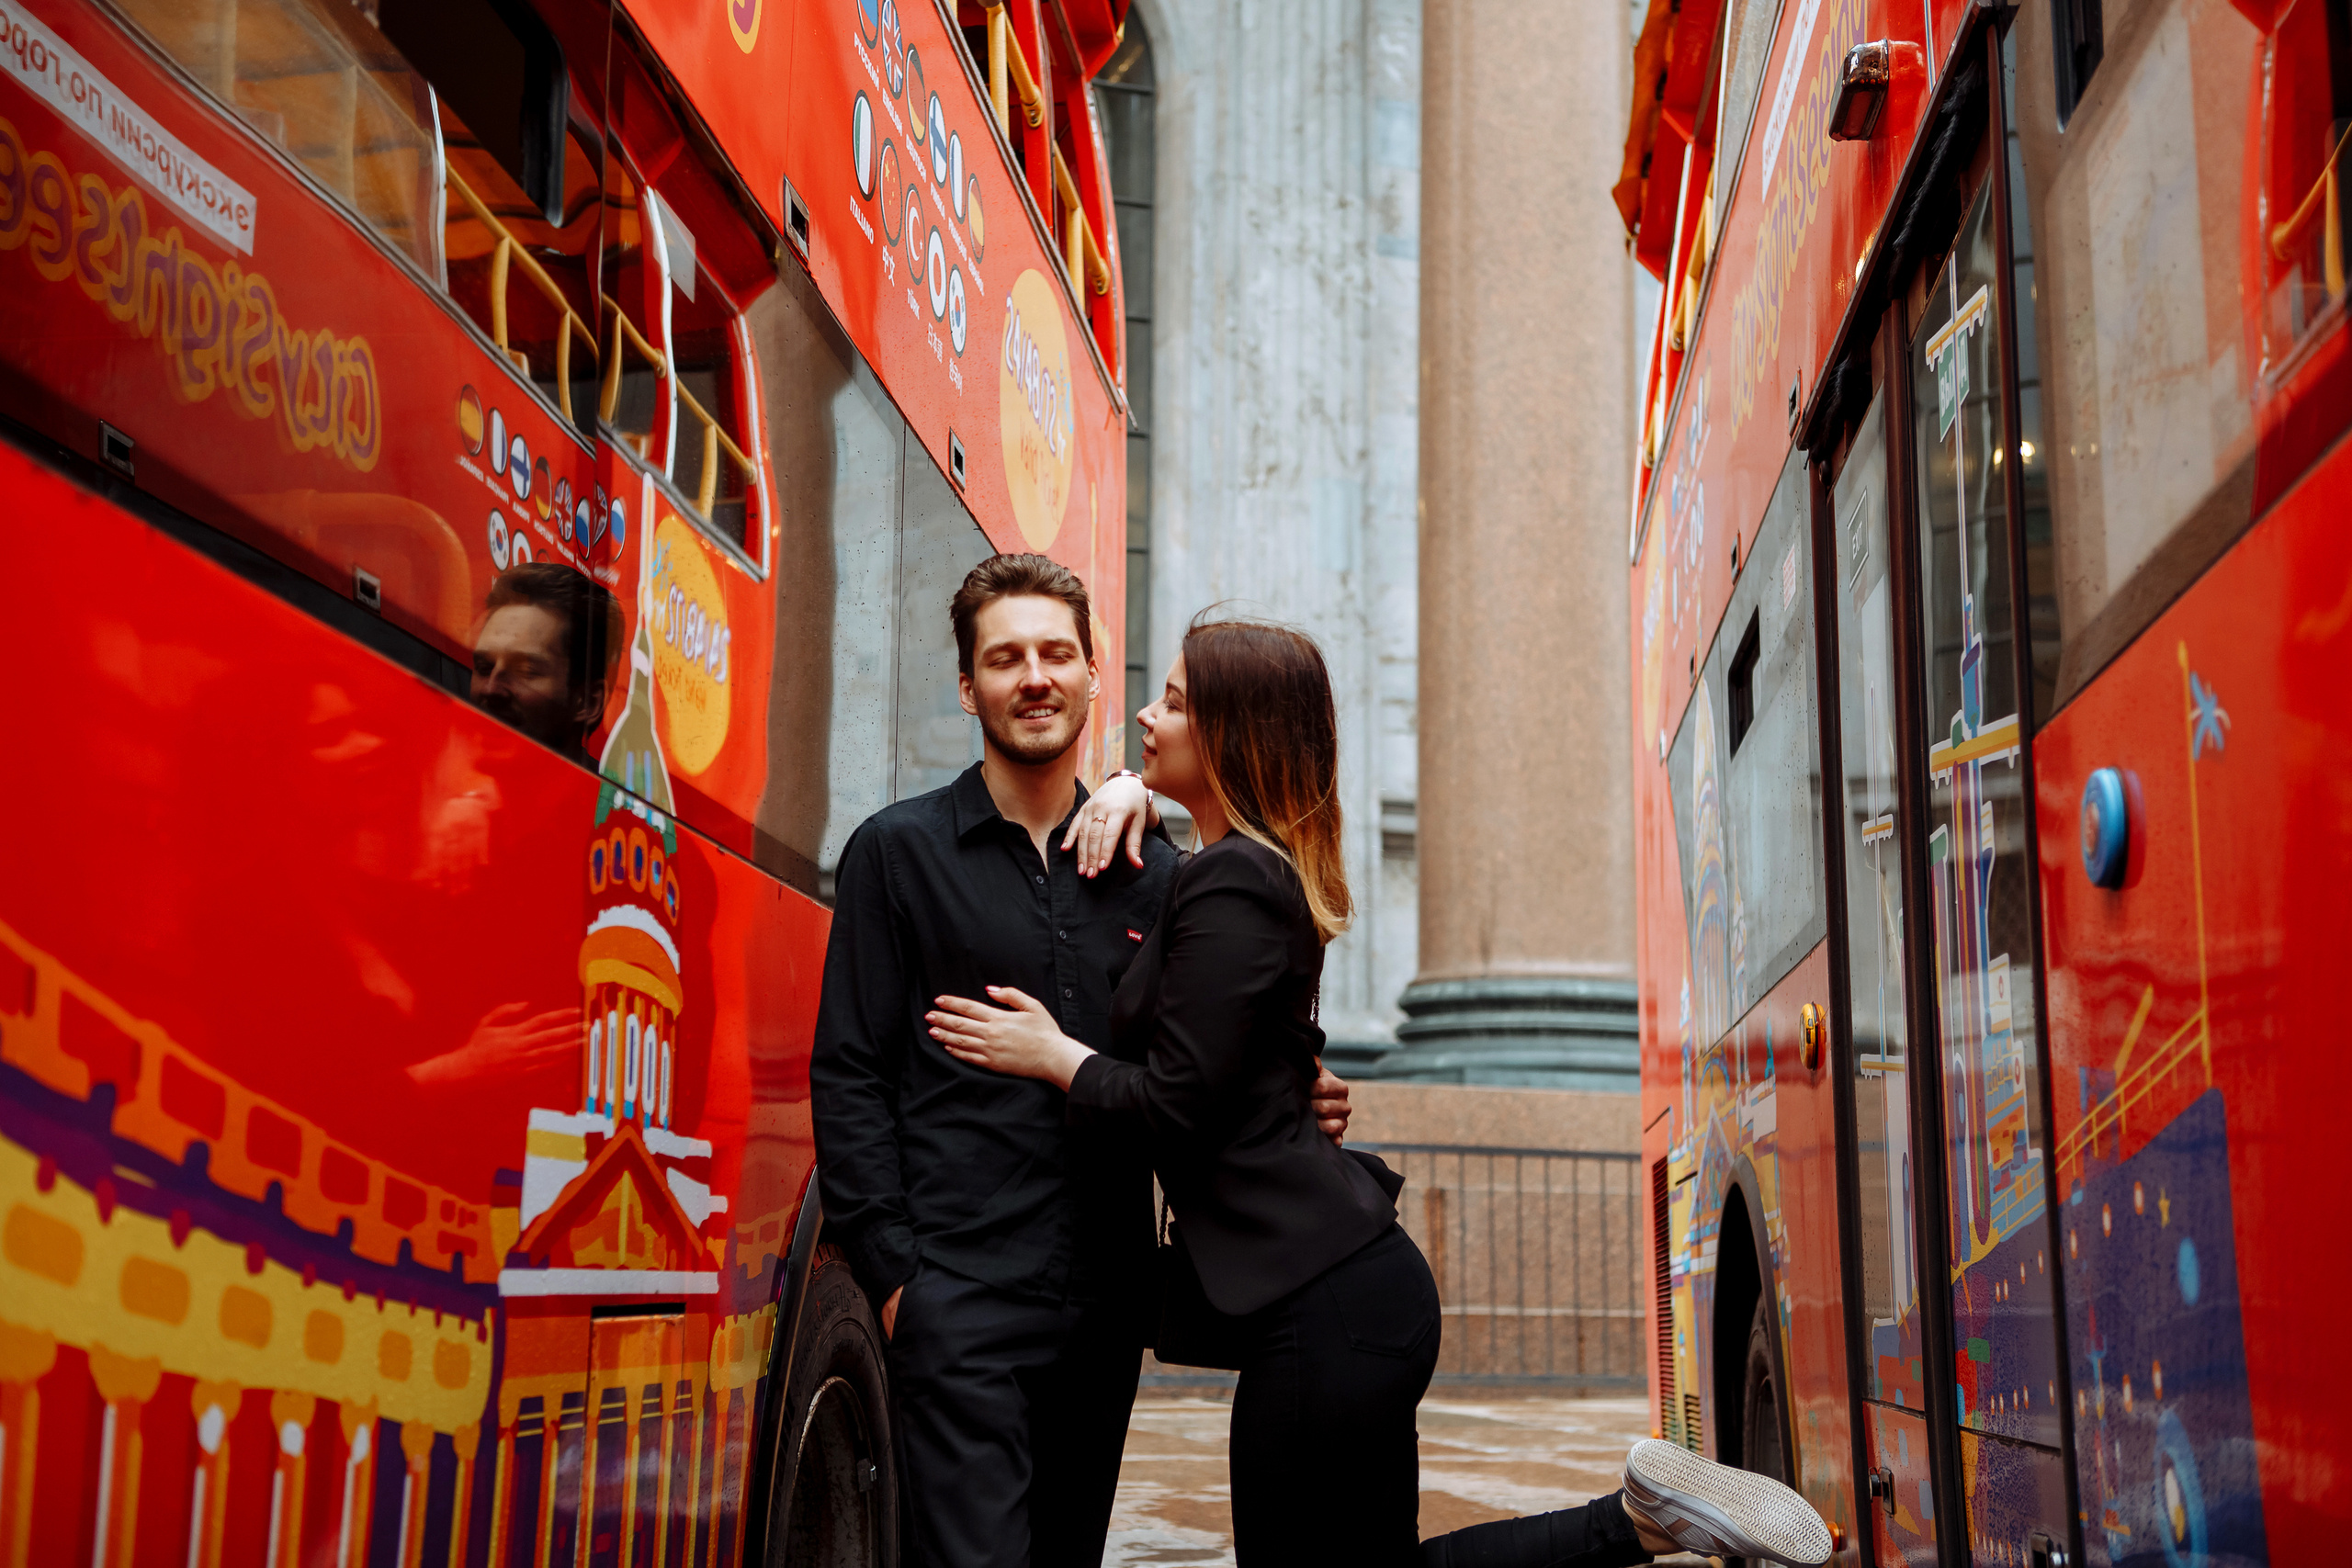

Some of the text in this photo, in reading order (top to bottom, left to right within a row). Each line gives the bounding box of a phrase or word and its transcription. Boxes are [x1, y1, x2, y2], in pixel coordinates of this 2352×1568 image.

[854, 32, 879, 91] РУССКИЙ
[882, 87, 902, 137] ENGLISH
[850, 195, 874, 244] ITALIANO
[882, 245, 896, 287] 中文
[1940, 333, 1968, 419] ВЫД
[1852, 520, 1862, 560] EXIT
